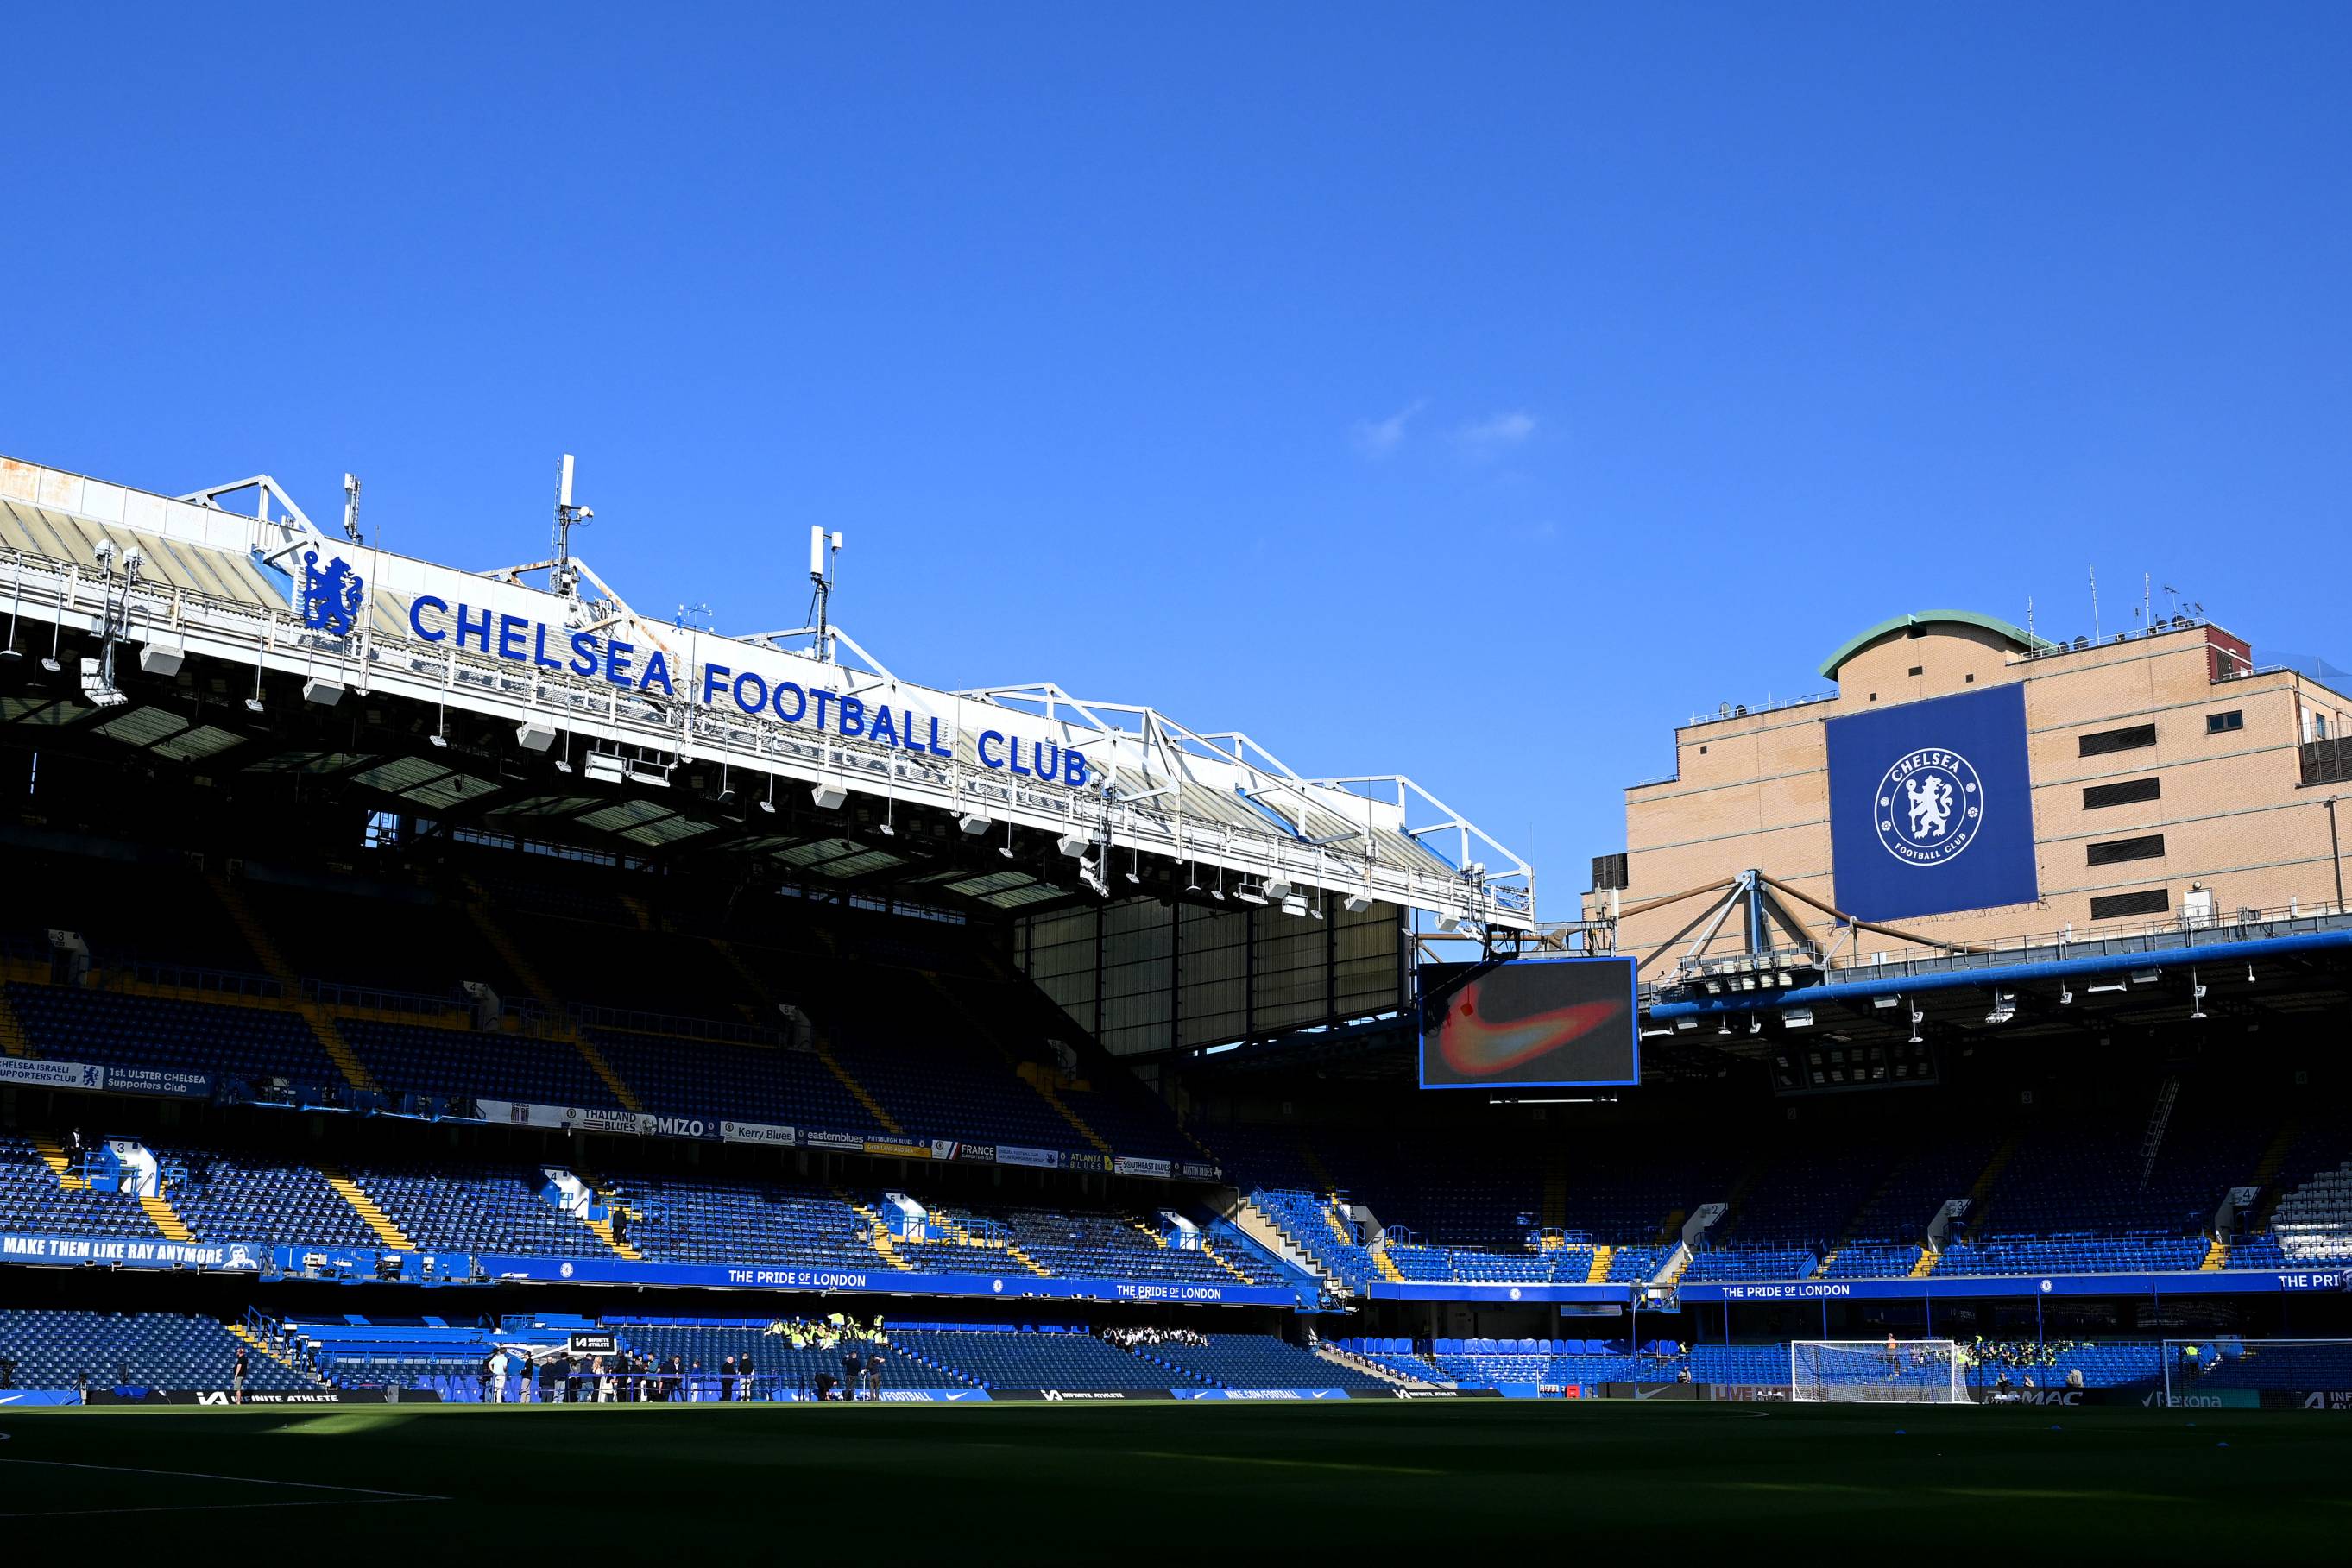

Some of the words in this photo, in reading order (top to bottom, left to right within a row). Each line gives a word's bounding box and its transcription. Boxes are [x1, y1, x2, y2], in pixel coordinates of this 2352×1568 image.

[410, 595, 673, 696] CHELSEA
[704, 663, 951, 758] FOOTBALL
[978, 730, 1086, 786] CLUB
[1891, 753, 1960, 782] CHELSEA
[1895, 842, 1941, 860] FOOTBALL
[1944, 833, 1966, 853] CLUB
[37, 1064, 69, 1074] ISRAELI
[53, 1074, 77, 1083] CLUB
[110, 1068, 126, 1078] 1st.
[129, 1070, 161, 1080] ULSTER
[164, 1073, 205, 1084] CHELSEA
[108, 1078, 161, 1092] Supporters
[163, 1082, 187, 1093] Club
[584, 1109, 637, 1123] THAILAND
[604, 1121, 636, 1132] BLUES
[658, 1117, 703, 1137] MIZO
[738, 1126, 764, 1140] Kerry
[766, 1130, 792, 1141] Blues
[808, 1130, 863, 1143] easternblues
[867, 1135, 898, 1144] PITTSBURGH
[117, 1143, 125, 1153] 3
[962, 1144, 994, 1156] FRANCE
[1070, 1153, 1101, 1162] ATLANTA
[1070, 1162, 1101, 1171] BLUES
[1123, 1161, 1154, 1170] SOUTHEAST
[1155, 1163, 1170, 1172] BLUES
[1183, 1165, 1199, 1175] AUSTIN
[1200, 1167, 1213, 1177] BLUES
[551, 1172, 557, 1181] 4
[890, 1195, 895, 1204] 5
[2243, 1188, 2250, 1199] 4
[1712, 1205, 1718, 1214] 2
[1957, 1200, 1963, 1210] 3
[3, 1237, 45, 1255] MAKE
[49, 1240, 90, 1257] THEM
[95, 1243, 124, 1259] LIKE
[128, 1244, 154, 1260] RAY
[157, 1244, 223, 1263] ANYMORE
[728, 1270, 754, 1283] THE
[757, 1271, 795, 1284] PRIDE
[798, 1273, 810, 1282] OF
[814, 1274, 866, 1287] LONDON
[2279, 1275, 2307, 1287] THE
[2313, 1275, 2339, 1287] PRI
[1117, 1285, 1135, 1296] THE
[1138, 1286, 1167, 1298] PRIDE
[1170, 1287, 1179, 1296] OF
[1181, 1288, 1221, 1299] LONDON
[1722, 1287, 1744, 1297] THE
[1747, 1287, 1781, 1297] PRIDE
[1785, 1286, 1795, 1294] OF
[1799, 1285, 1850, 1296] LONDON
[1224, 1390, 1302, 1399] NIKE.COM/FOOTBALL
[1716, 1386, 1753, 1401] LIVE
